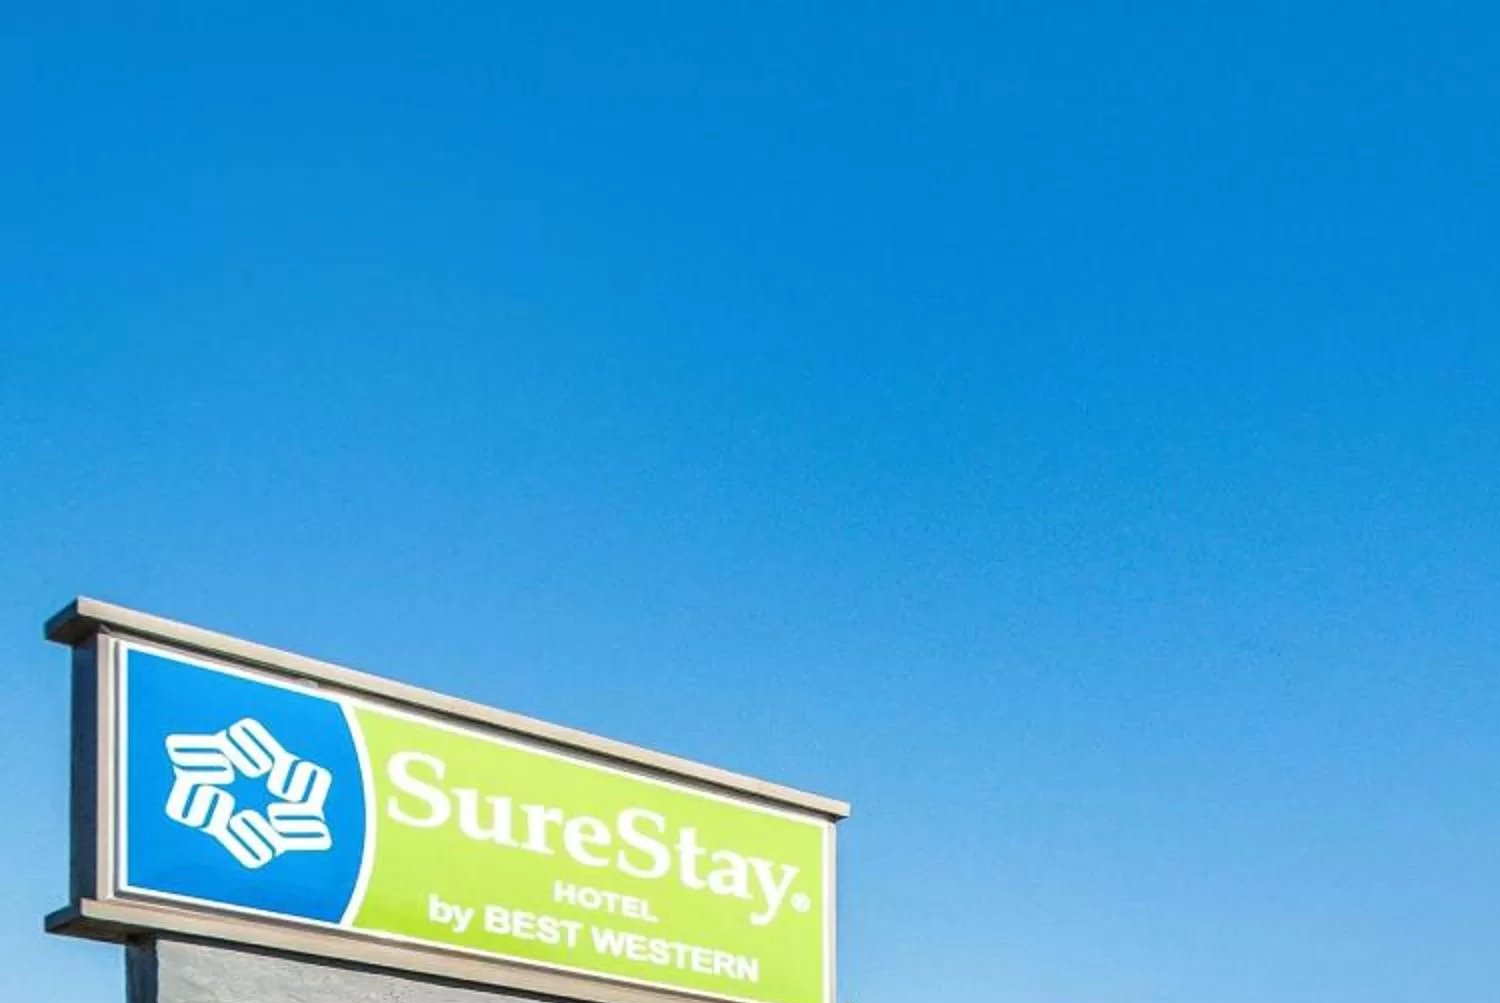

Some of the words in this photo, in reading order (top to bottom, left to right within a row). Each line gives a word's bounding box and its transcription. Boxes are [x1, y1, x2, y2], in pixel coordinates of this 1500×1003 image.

[553, 879, 660, 924] HOTEL
[428, 892, 475, 934] by
[483, 903, 584, 949] BEST
[590, 925, 760, 983] WESTERN
